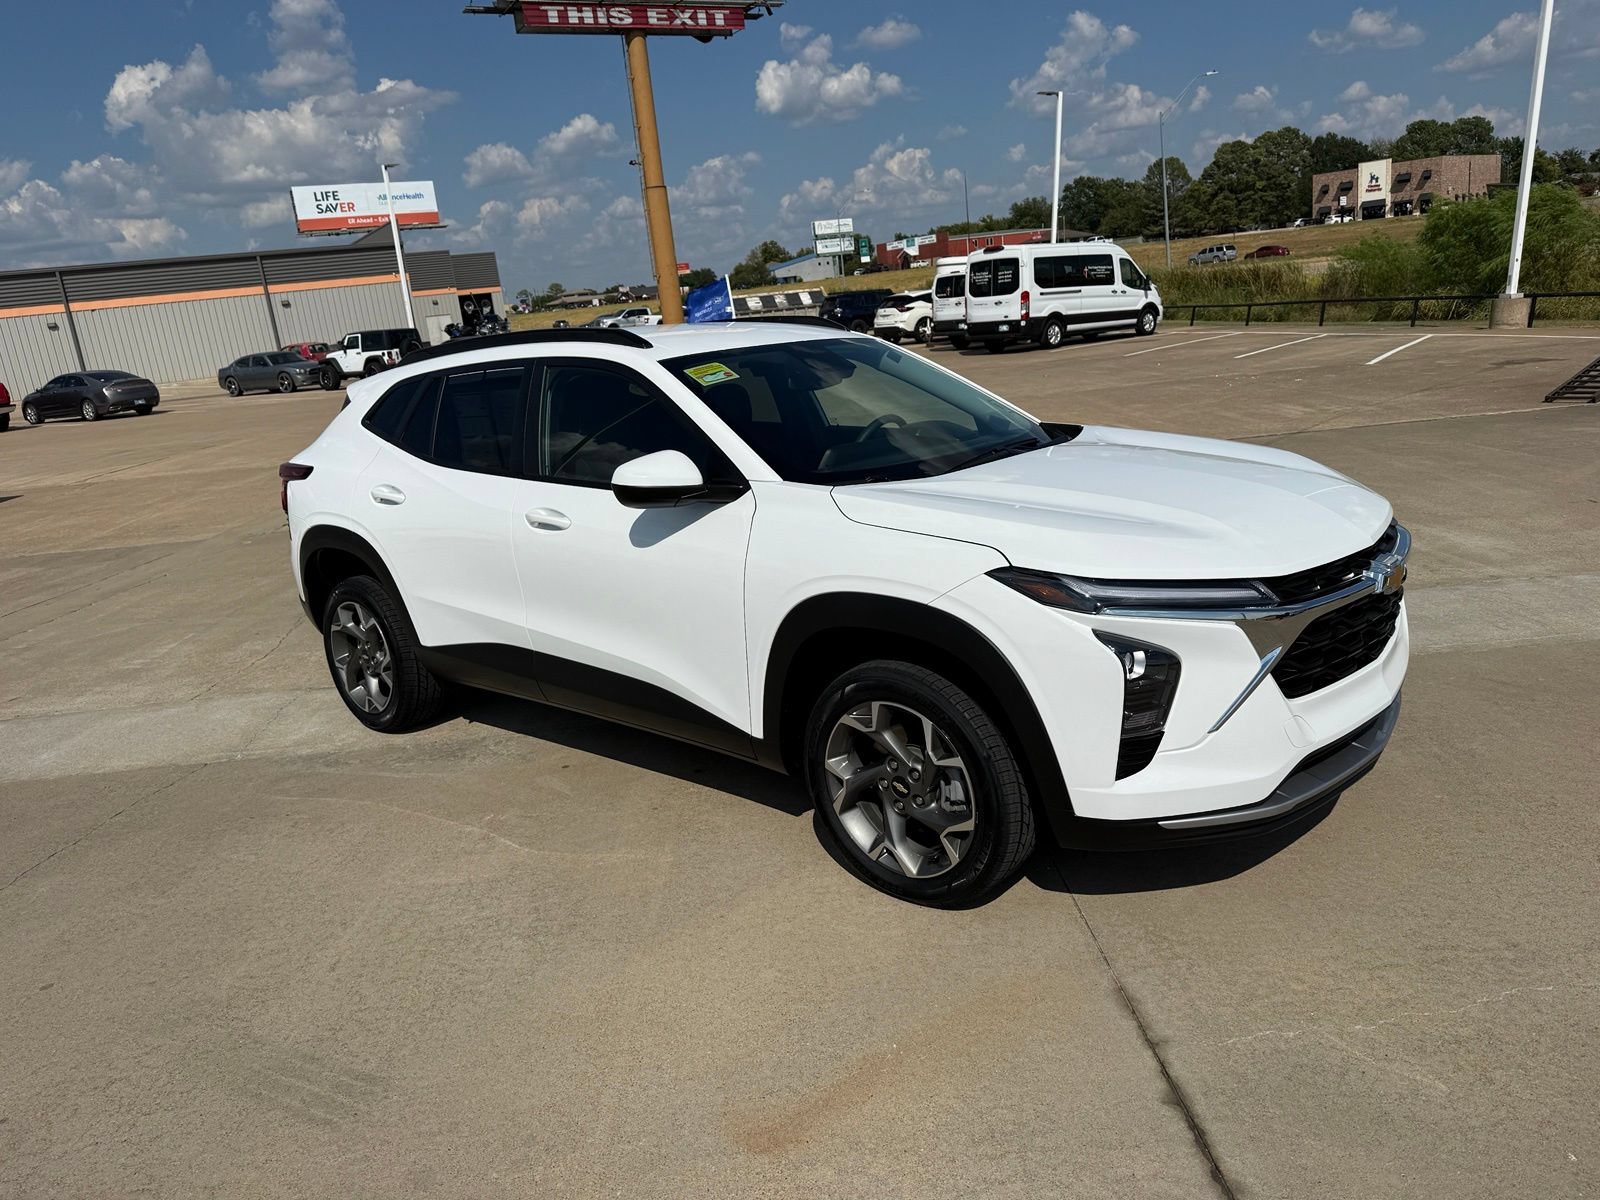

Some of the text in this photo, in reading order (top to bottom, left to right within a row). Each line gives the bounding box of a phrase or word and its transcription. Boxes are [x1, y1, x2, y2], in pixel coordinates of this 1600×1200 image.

[538, 6, 730, 26] THIS EXIT
[314, 190, 340, 202] LIFE
[377, 192, 424, 201] AllnceHealth
[315, 201, 356, 214] SAVER
